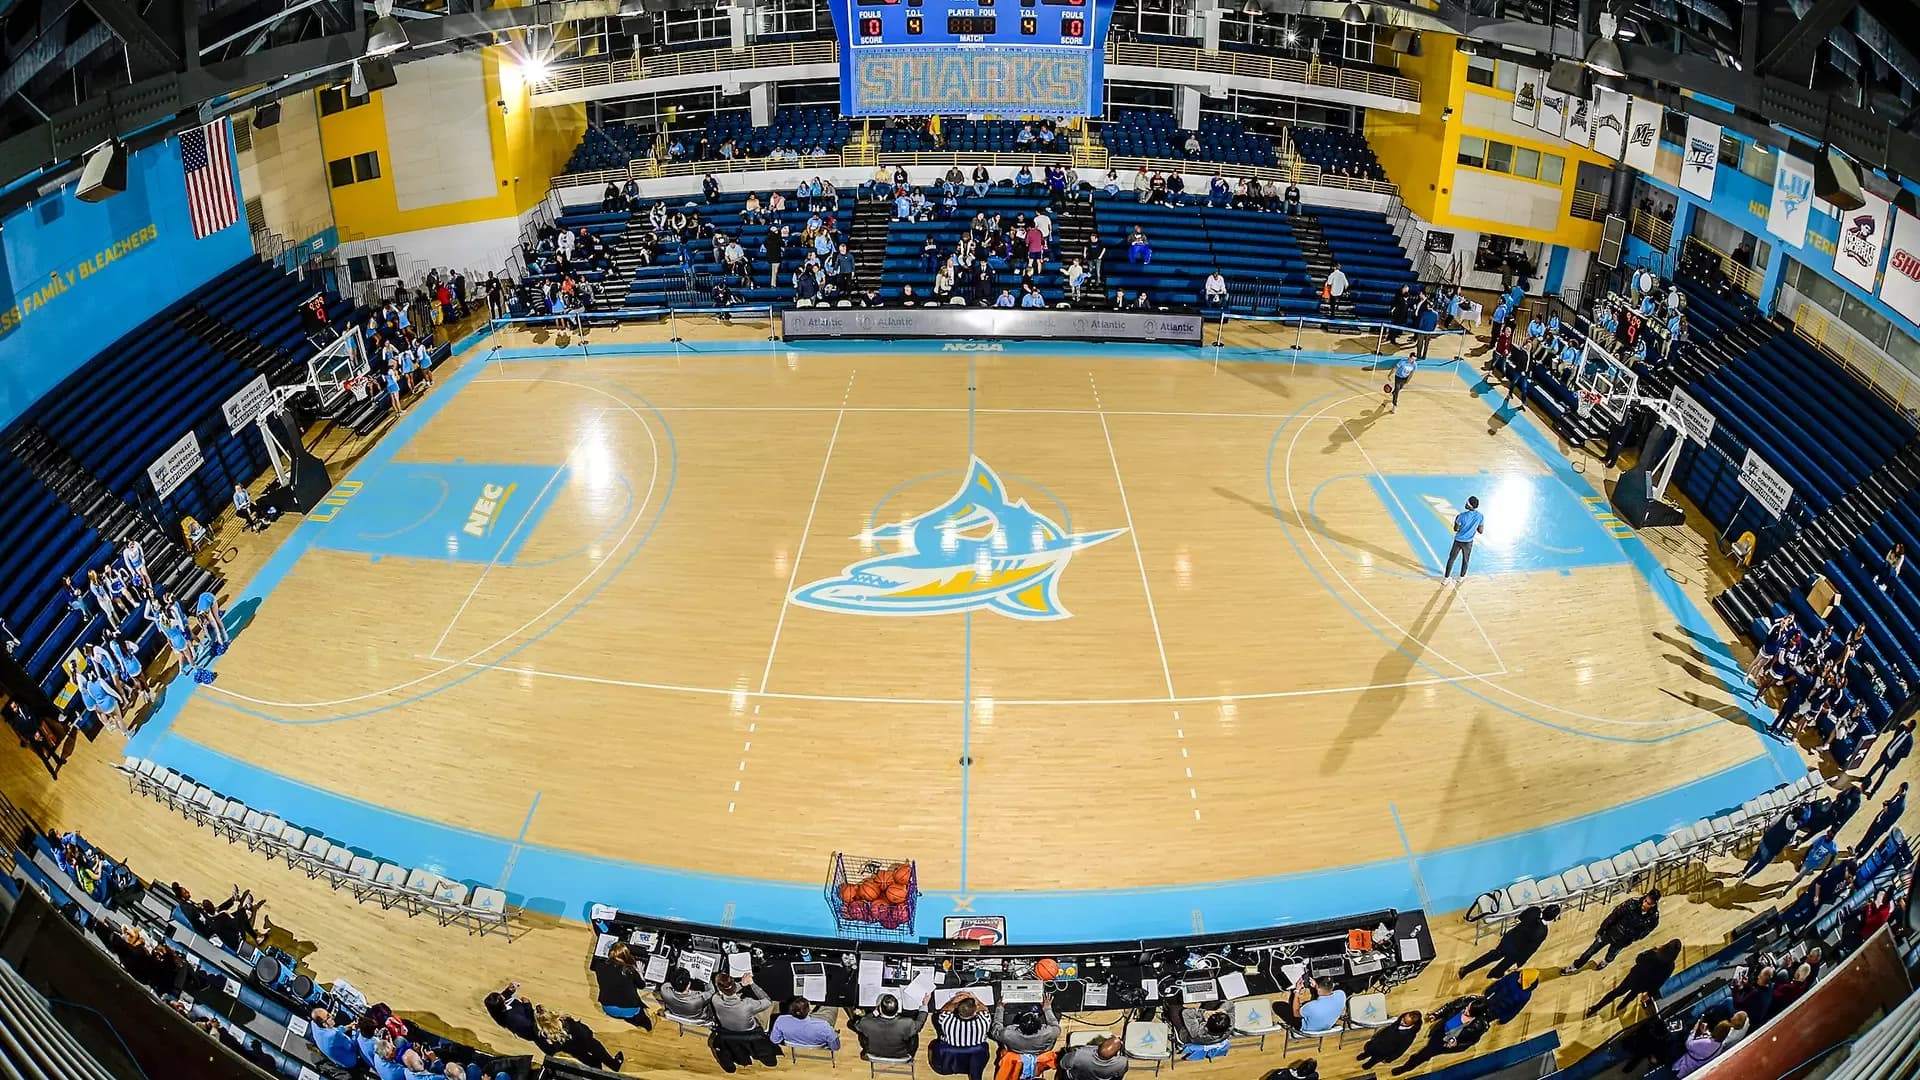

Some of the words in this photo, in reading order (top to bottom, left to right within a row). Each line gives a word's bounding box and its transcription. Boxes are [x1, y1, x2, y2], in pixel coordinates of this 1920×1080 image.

[859, 10, 882, 19] FOULS
[905, 9, 924, 17] T.O.L.
[948, 8, 975, 17] PLAYER
[979, 8, 997, 17] FOUL
[1020, 9, 1038, 17] T.O.L.
[1061, 10, 1084, 19] FOULS
[869, 19, 880, 35] 0
[909, 19, 920, 33] 4
[1023, 19, 1034, 33] 4
[1071, 20, 1082, 36] 0
[860, 36, 883, 44] SCORE
[959, 34, 984, 42] MATCH
[1060, 36, 1084, 44] SCORE
[860, 55, 1087, 104] SHARKS
[1686, 149, 1715, 165] NEC
[1778, 168, 1811, 200] LIU
[1845, 229, 1876, 253] ROBERT
[23, 267, 77, 316] FAMILY
[78, 223, 159, 280] BLEACHERS
[316, 308, 327, 323] 9
[808, 316, 842, 327] Atlantic
[1091, 320, 1126, 329] Atlantic
[1160, 321, 1194, 332] Atlantic
[1627, 326, 1636, 344] 9
[942, 343, 1004, 352] NCAA
[169, 447, 197, 474] CONFERENCE
[1761, 470, 1787, 495] NORTHEAST
[1757, 476, 1785, 505] CONFERENCE
[307, 480, 365, 523] LIU
[462, 482, 504, 537] NEC
[1580, 496, 1635, 539] LIU
